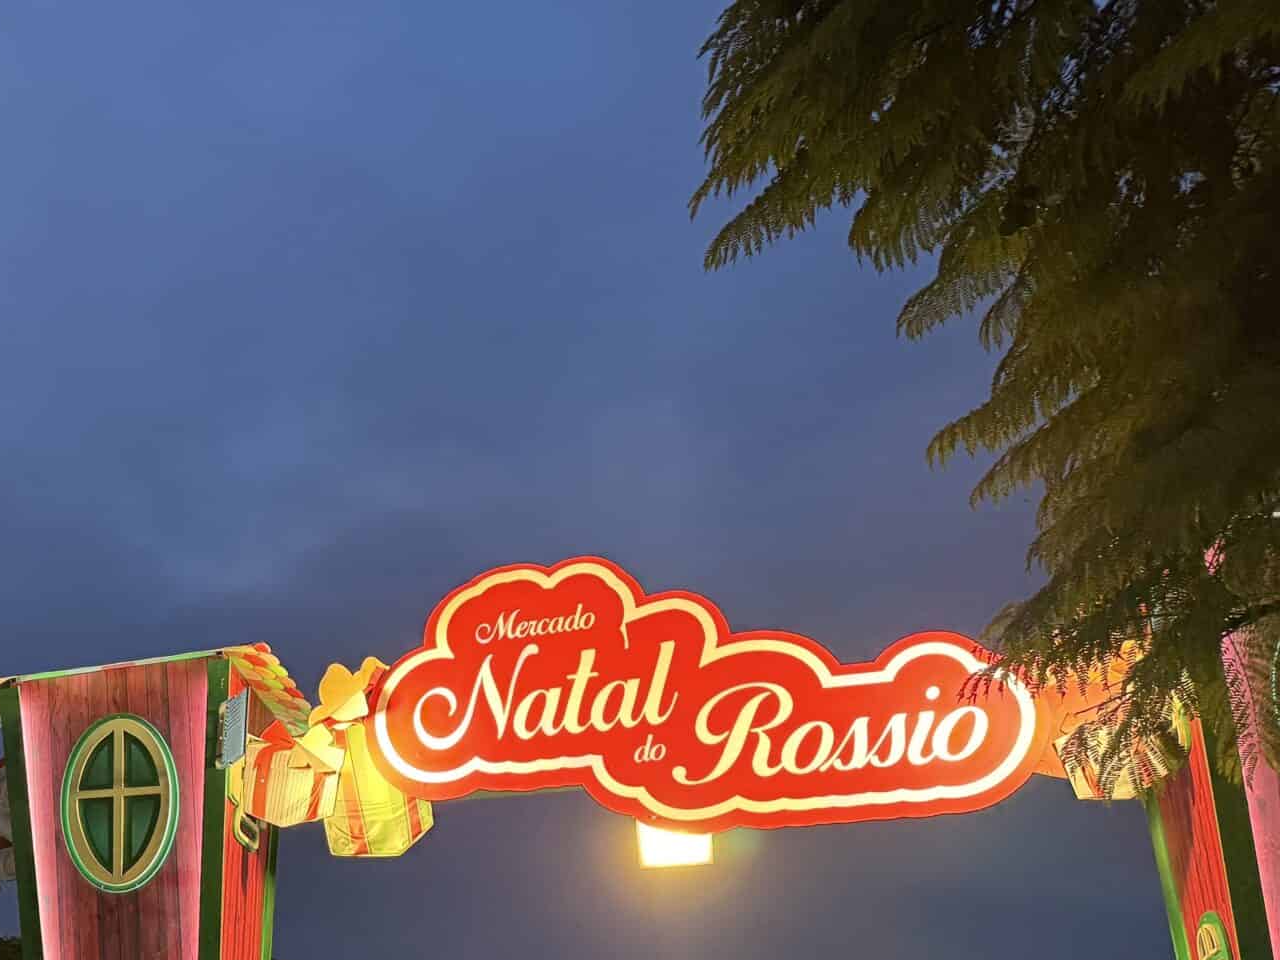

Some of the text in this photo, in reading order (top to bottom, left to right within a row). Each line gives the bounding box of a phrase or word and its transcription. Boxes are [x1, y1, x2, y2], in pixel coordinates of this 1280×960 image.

[475, 602, 596, 645] Mercado
[413, 640, 679, 750] Natal
[633, 681, 989, 786] do Rossio
